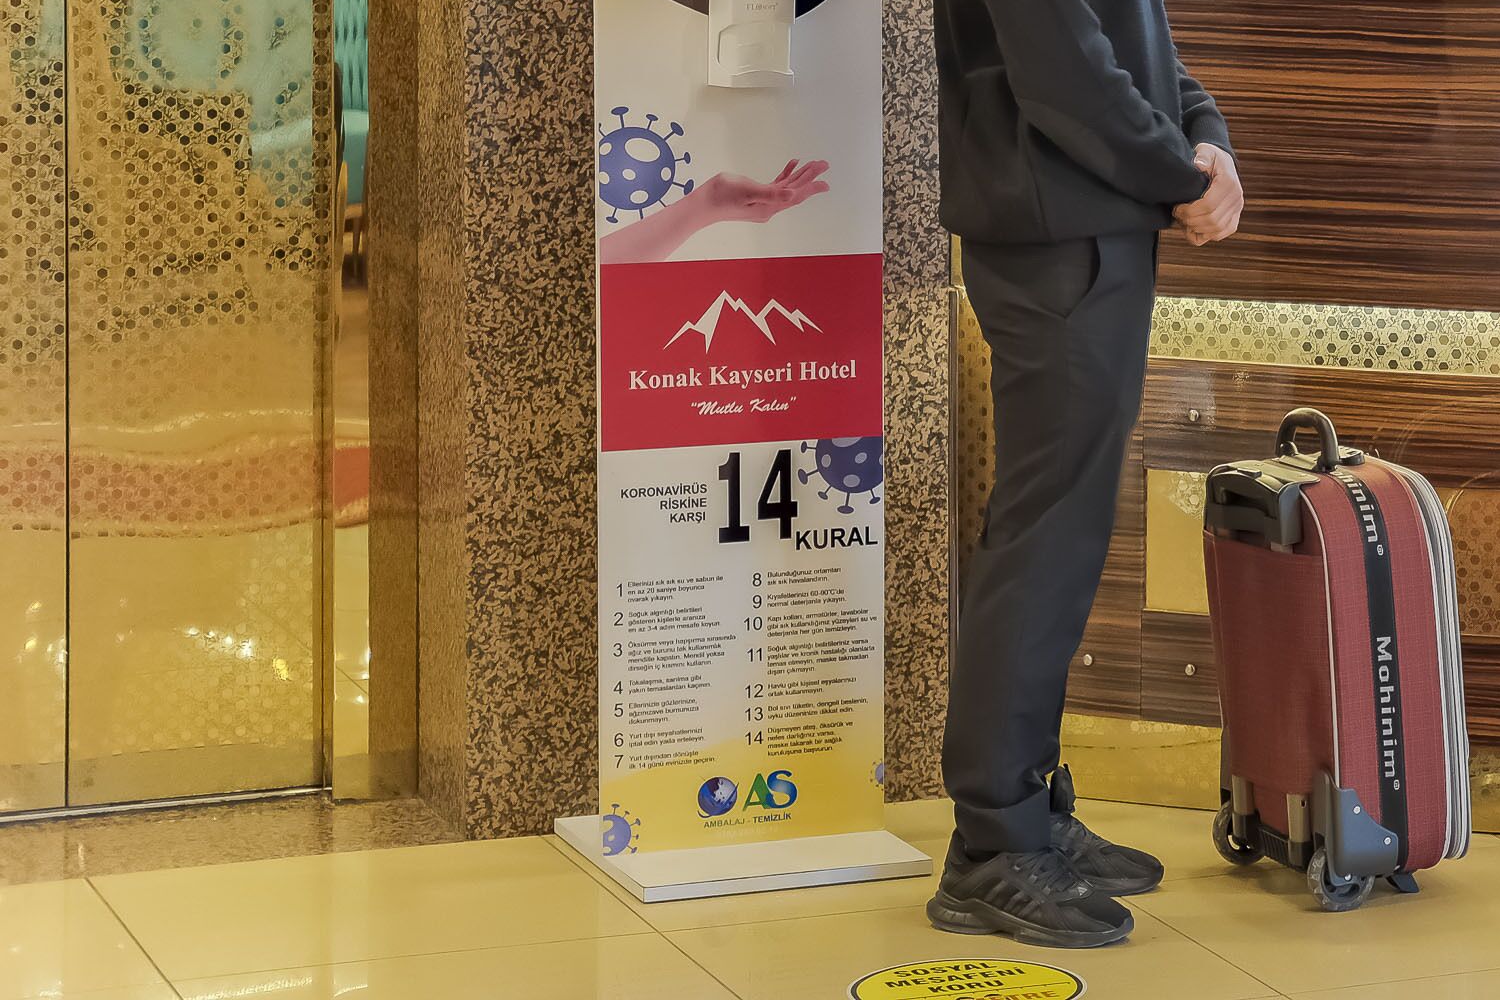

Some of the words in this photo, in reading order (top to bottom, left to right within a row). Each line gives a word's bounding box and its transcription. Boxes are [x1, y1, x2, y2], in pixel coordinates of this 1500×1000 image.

[629, 367, 702, 390] Konak
[709, 362, 792, 389] Kayseri
[799, 359, 857, 381] Hotel
[620, 482, 707, 499] KORONAVİRÜS
[717, 448, 799, 544] 14
[659, 495, 707, 510] RİSKİNE
[669, 511, 706, 524] KARŞI
[795, 526, 879, 551] KURAL
[752, 573, 762, 587] 8
[616, 584, 623, 597] 1
[752, 594, 762, 609] 9
[614, 612, 624, 626] 2
[744, 616, 763, 631] 10
[613, 643, 623, 657] 3
[747, 648, 763, 662] 11
[613, 681, 623, 694] 4
[745, 684, 764, 698] 12
[614, 703, 624, 717] 5
[745, 707, 763, 721] 13
[614, 733, 624, 747] 6
[745, 731, 764, 745] 14
[614, 754, 624, 768] 7
[743, 769, 798, 812] AS
[703, 818, 745, 829] AMBALAJ
[752, 811, 792, 824] TEMİZLİK
[894, 961, 998, 978] SOSYAL
[884, 966, 1027, 988] MESAFENİ
[927, 980, 1004, 993] KORU
